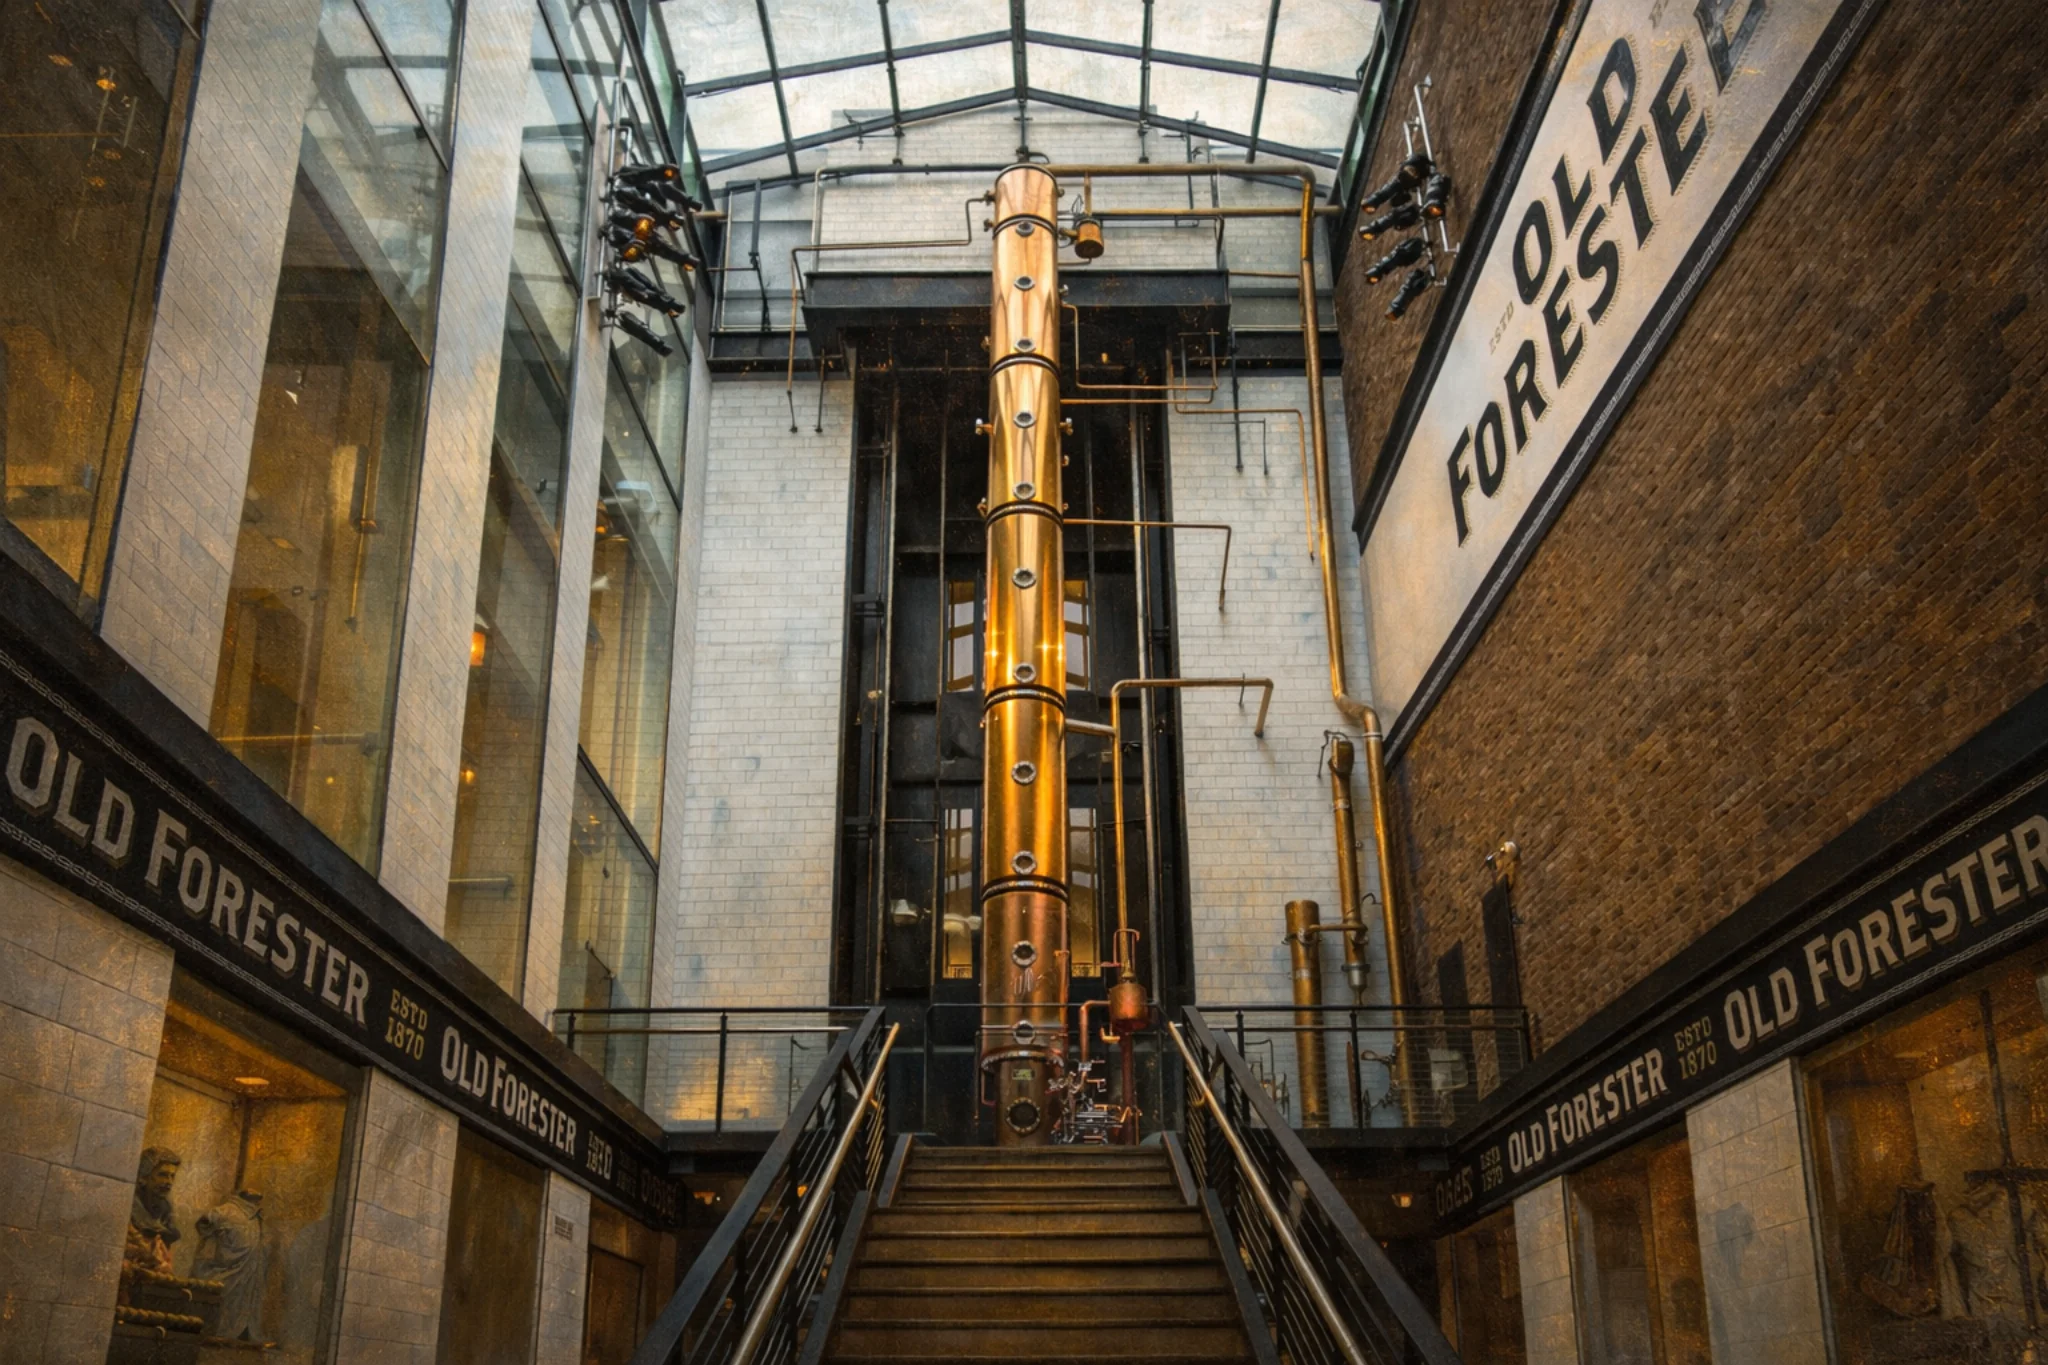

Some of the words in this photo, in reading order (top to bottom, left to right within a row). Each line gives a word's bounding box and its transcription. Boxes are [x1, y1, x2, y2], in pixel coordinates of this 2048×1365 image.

[1512, 37, 1639, 306] OLD
[5, 716, 136, 860] OLD
[145, 808, 371, 1026] FORESTER
[1723, 967, 1800, 1051] OLD
[1802, 814, 2048, 1009] FORESTER
[384, 1015, 426, 1061] 1870
[390, 989, 429, 1032] ESTD
[1677, 1041, 1718, 1081] 1870
[440, 1026, 490, 1099] OLD
[491, 1055, 577, 1156] FORESTER
[1507, 1131, 1546, 1174] OLD
[1545, 1048, 1668, 1154] FORESTER
